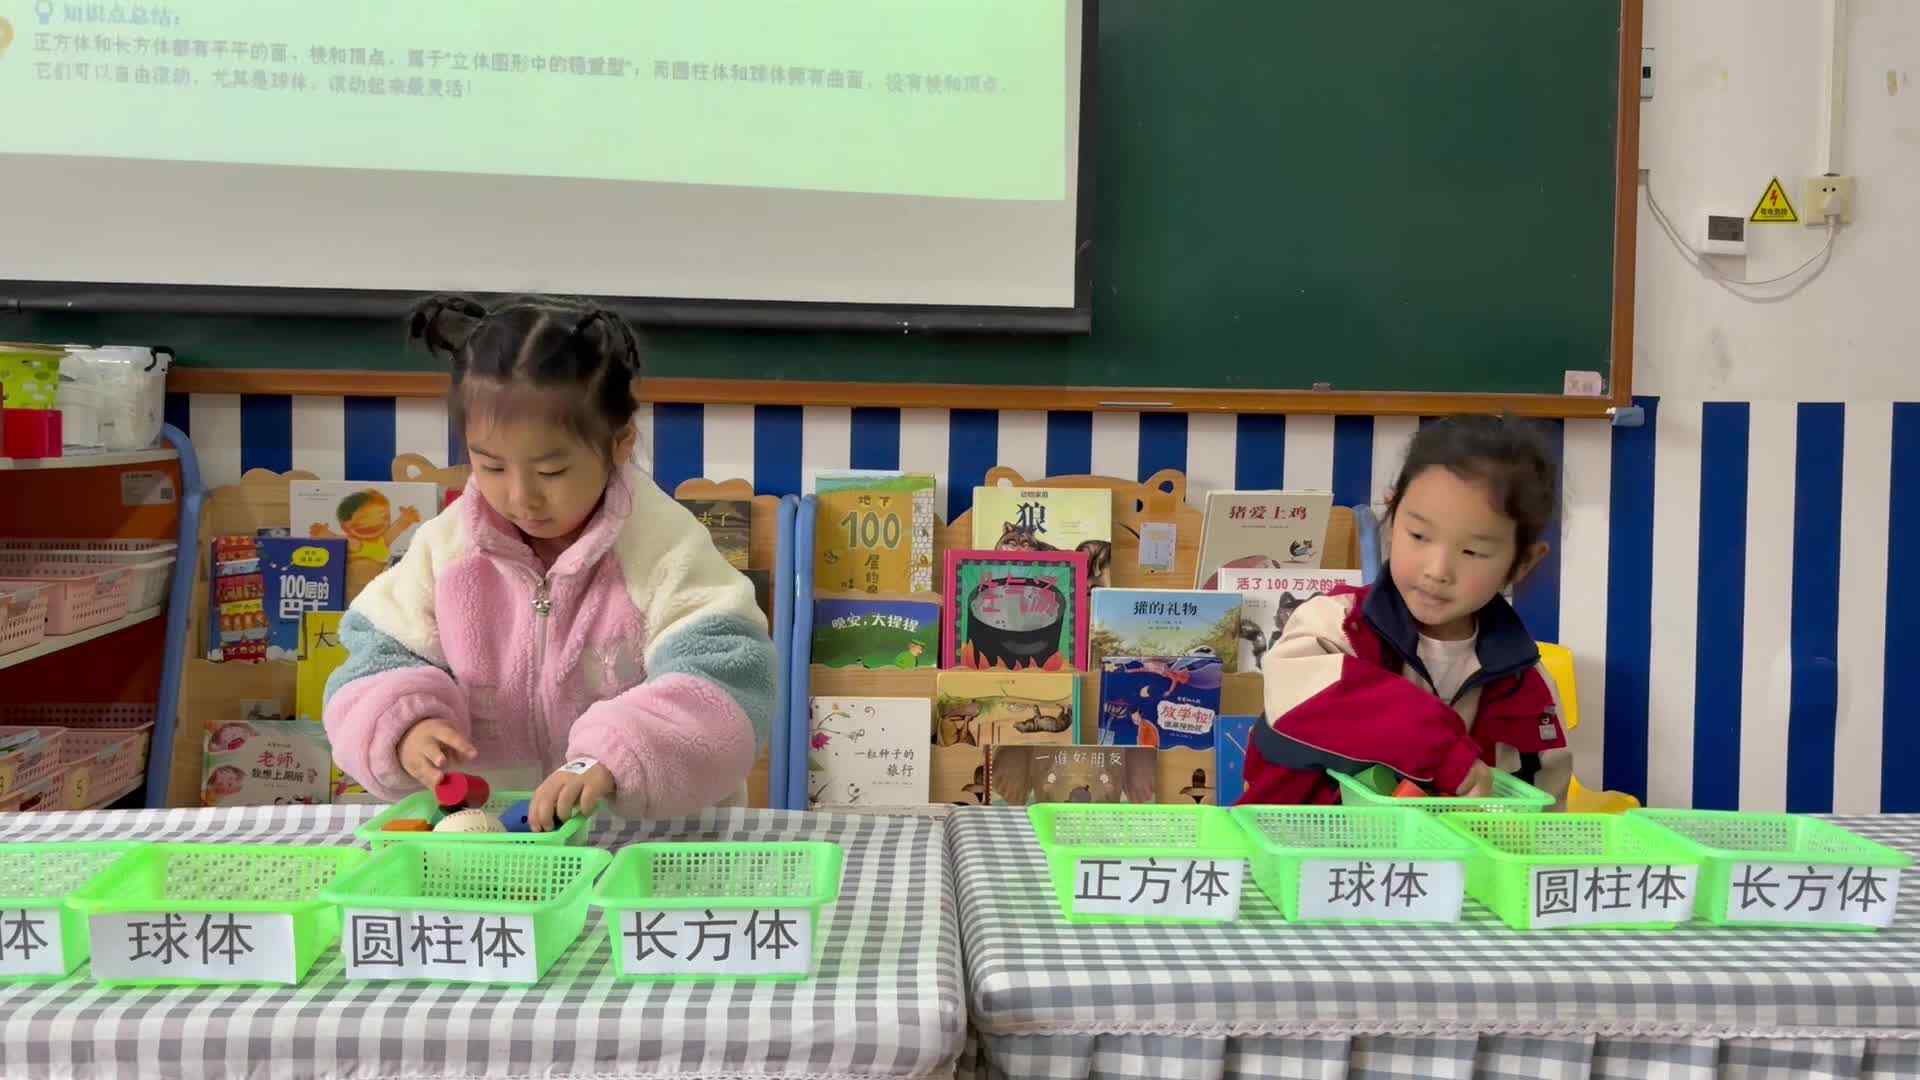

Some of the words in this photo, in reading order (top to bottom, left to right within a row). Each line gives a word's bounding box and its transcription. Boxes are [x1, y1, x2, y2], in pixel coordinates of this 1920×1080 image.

[841, 511, 901, 549] 100
[1016, 501, 1048, 534] 狼
[1229, 505, 1307, 520] 猪爱上鸡
[280, 574, 330, 600] 100层的
[1134, 601, 1198, 616] 獾的礼物
[1075, 857, 1230, 906] 正方体
[1328, 861, 1429, 908] 球体
[1535, 863, 1688, 917] 圆柱体
[1732, 864, 1888, 912] 长方体
[0, 909, 48, 960] 体
[127, 912, 254, 965] 球体
[352, 914, 526, 968] 圆柱体
[623, 908, 799, 961] 长方体
